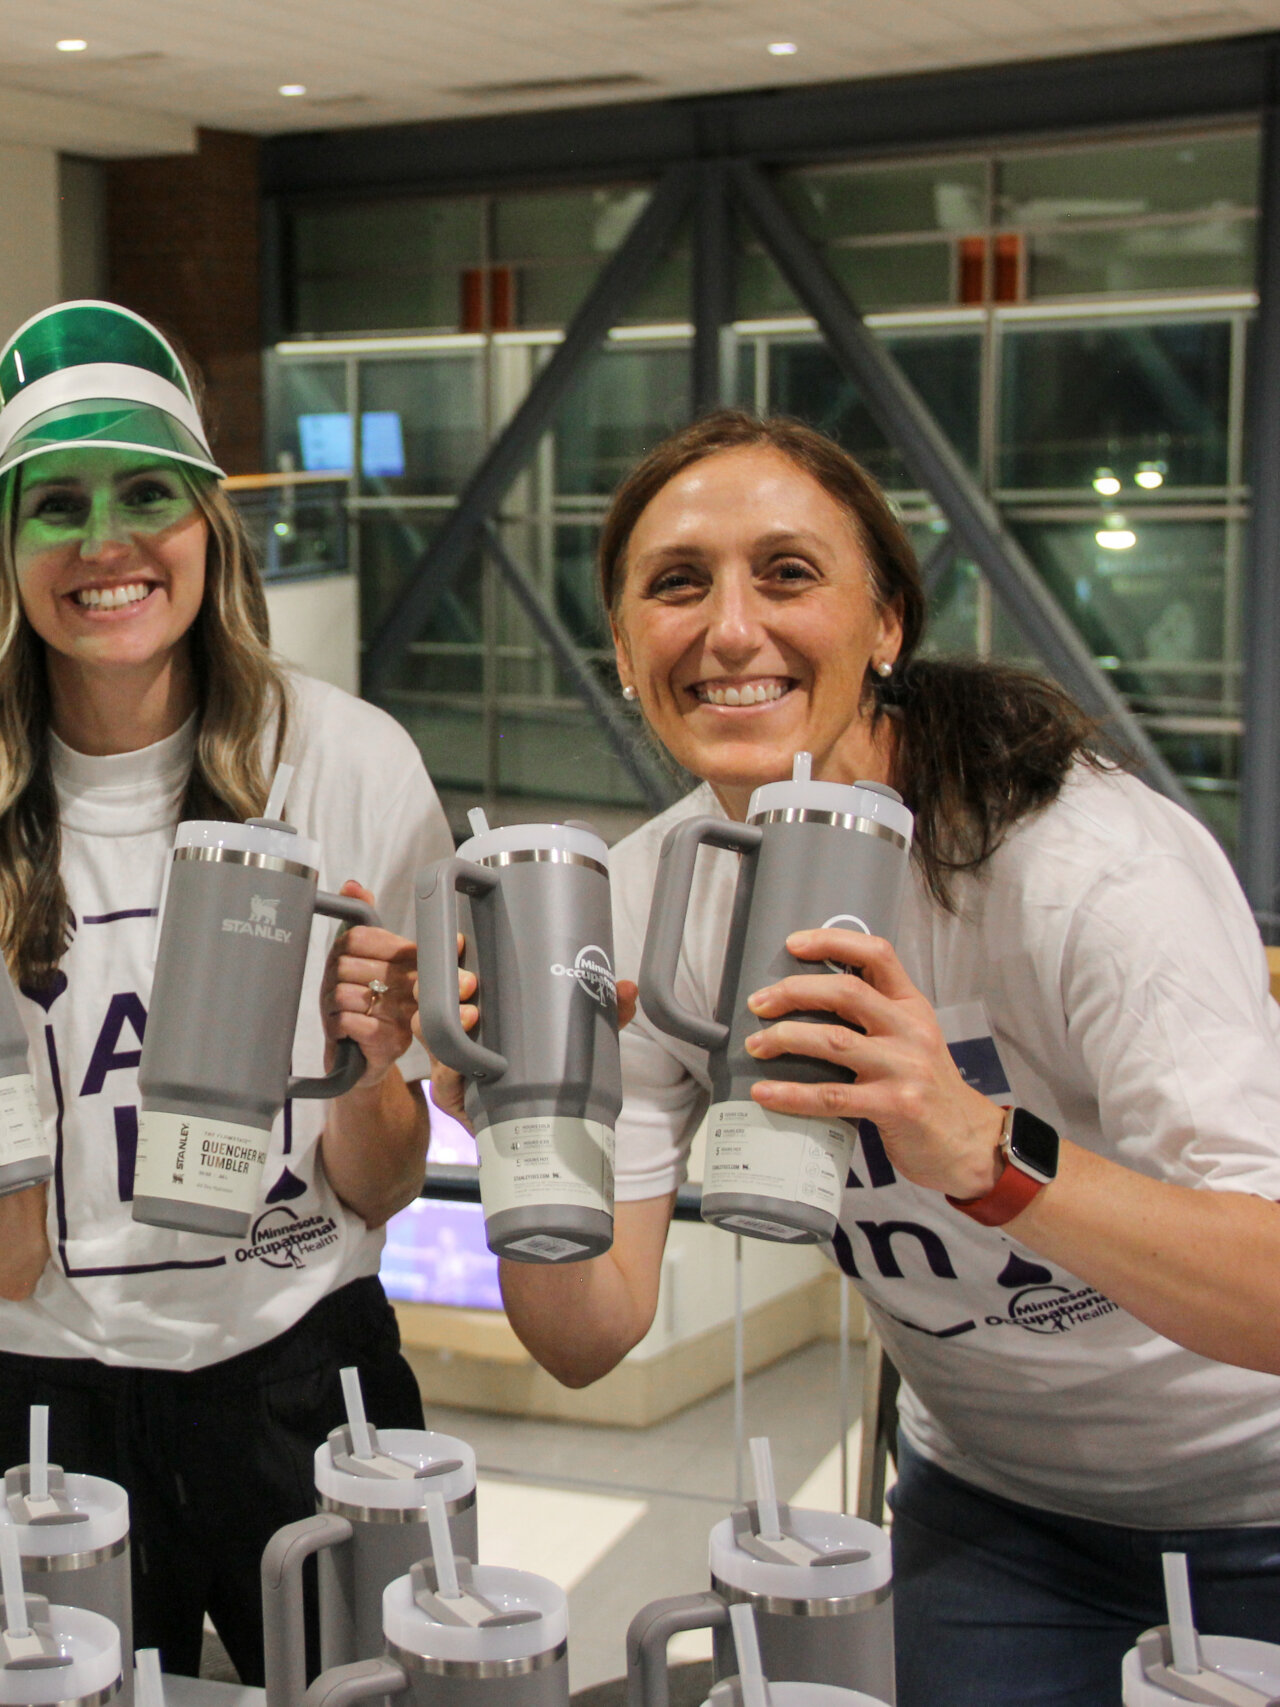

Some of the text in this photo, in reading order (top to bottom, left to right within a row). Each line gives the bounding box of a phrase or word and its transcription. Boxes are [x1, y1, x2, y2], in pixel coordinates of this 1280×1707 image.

[222, 918, 292, 944] STANLEY
[176, 1122, 190, 1170] STANLEY
[202, 1139, 258, 1161] QUENCHER
[200, 1153, 250, 1174] TUMBLER
[234, 1218, 337, 1262] Occupational
[257, 1215, 325, 1242] Minnesota
[297, 1232, 339, 1255] Health
[1067, 1301, 1120, 1325] Health
